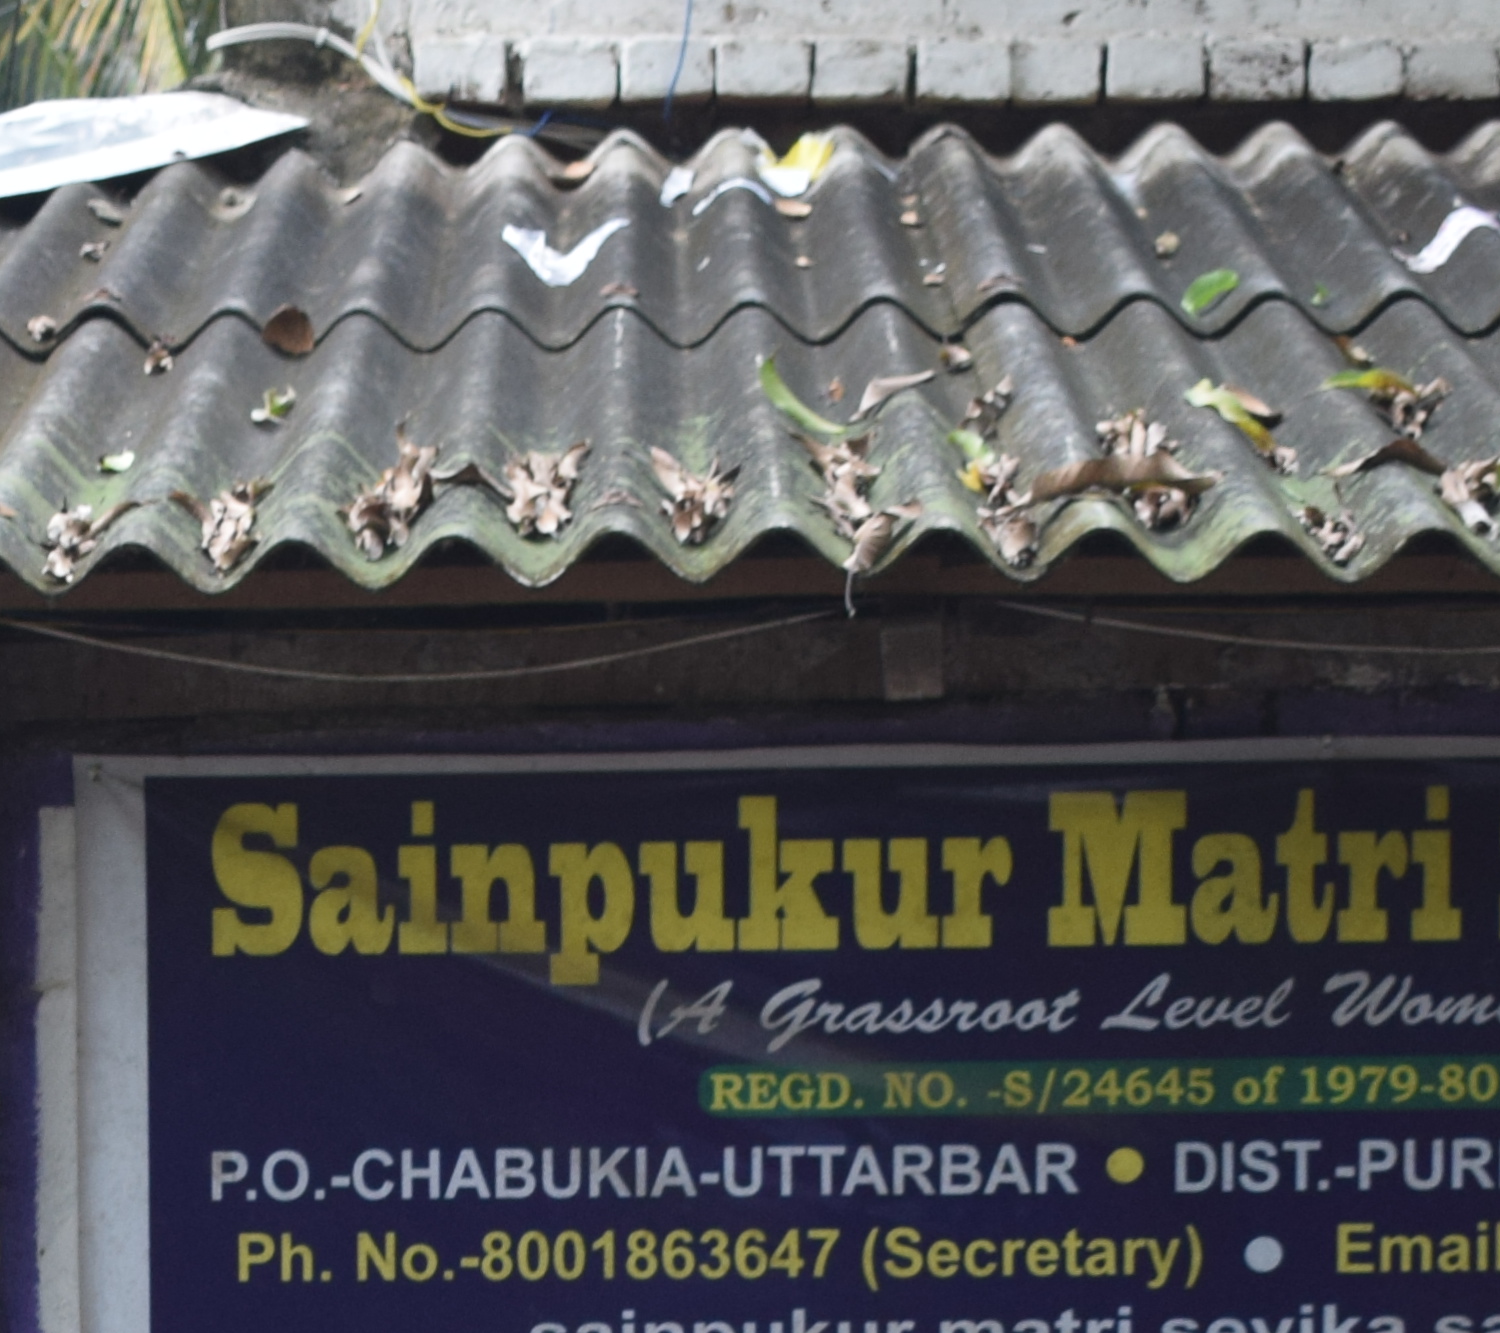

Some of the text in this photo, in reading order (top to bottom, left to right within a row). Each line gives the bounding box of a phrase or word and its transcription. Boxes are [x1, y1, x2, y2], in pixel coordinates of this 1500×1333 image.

[212, 797, 1013, 985] Sainpukur
[1048, 787, 1461, 946] Matri
[638, 979, 733, 1046] (A
[761, 978, 1080, 1053] Grassroot
[1101, 973, 1294, 1032] Level
[710, 1071, 864, 1110] REGD.
[883, 1071, 967, 1108] NO.
[1232, 1066, 1280, 1103] of
[1301, 1064, 1500, 1103] 1979-80
[210, 1143, 1079, 1202] P.O.-CHABUKIA-UTTARBAR
[237, 1232, 332, 1282] Ph.
[357, 1229, 841, 1283] No.-8001863647
[862, 1225, 1203, 1291] (Secretary)
